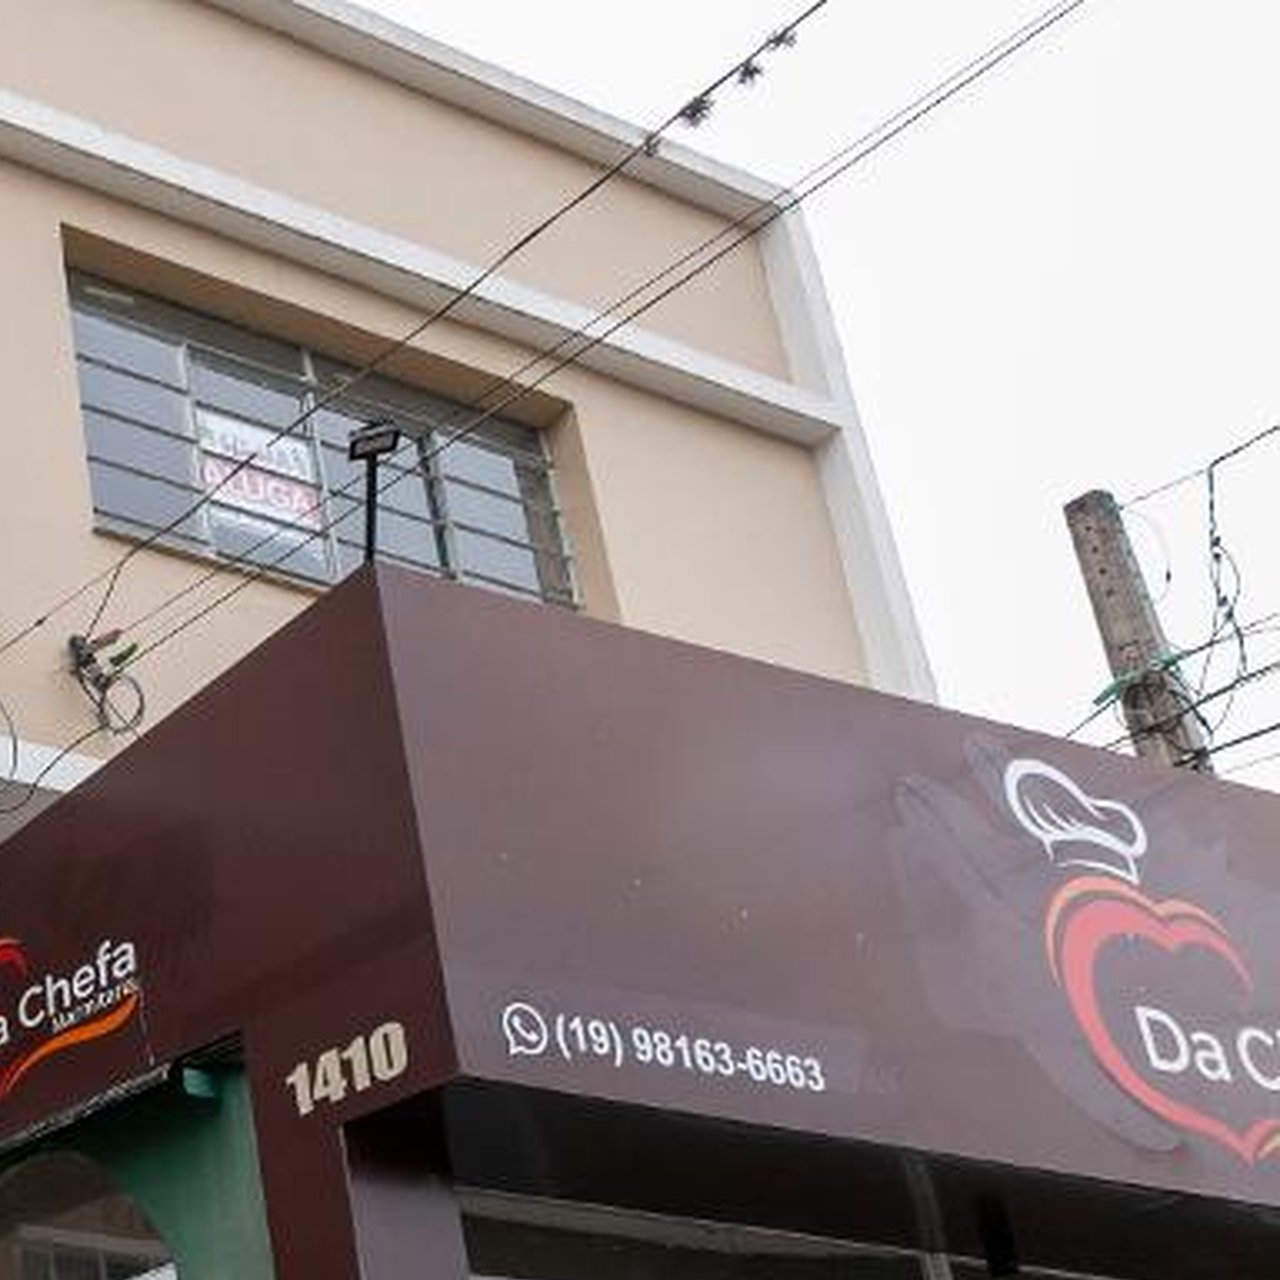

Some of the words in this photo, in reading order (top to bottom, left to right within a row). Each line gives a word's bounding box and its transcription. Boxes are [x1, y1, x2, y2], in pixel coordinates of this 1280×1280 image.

[18, 940, 137, 1028] Chefa
[286, 1020, 408, 1118] 1410
[555, 1014, 623, 1068] (19)
[632, 1027, 826, 1091] 98163-6663
[1134, 1005, 1232, 1082] Da
